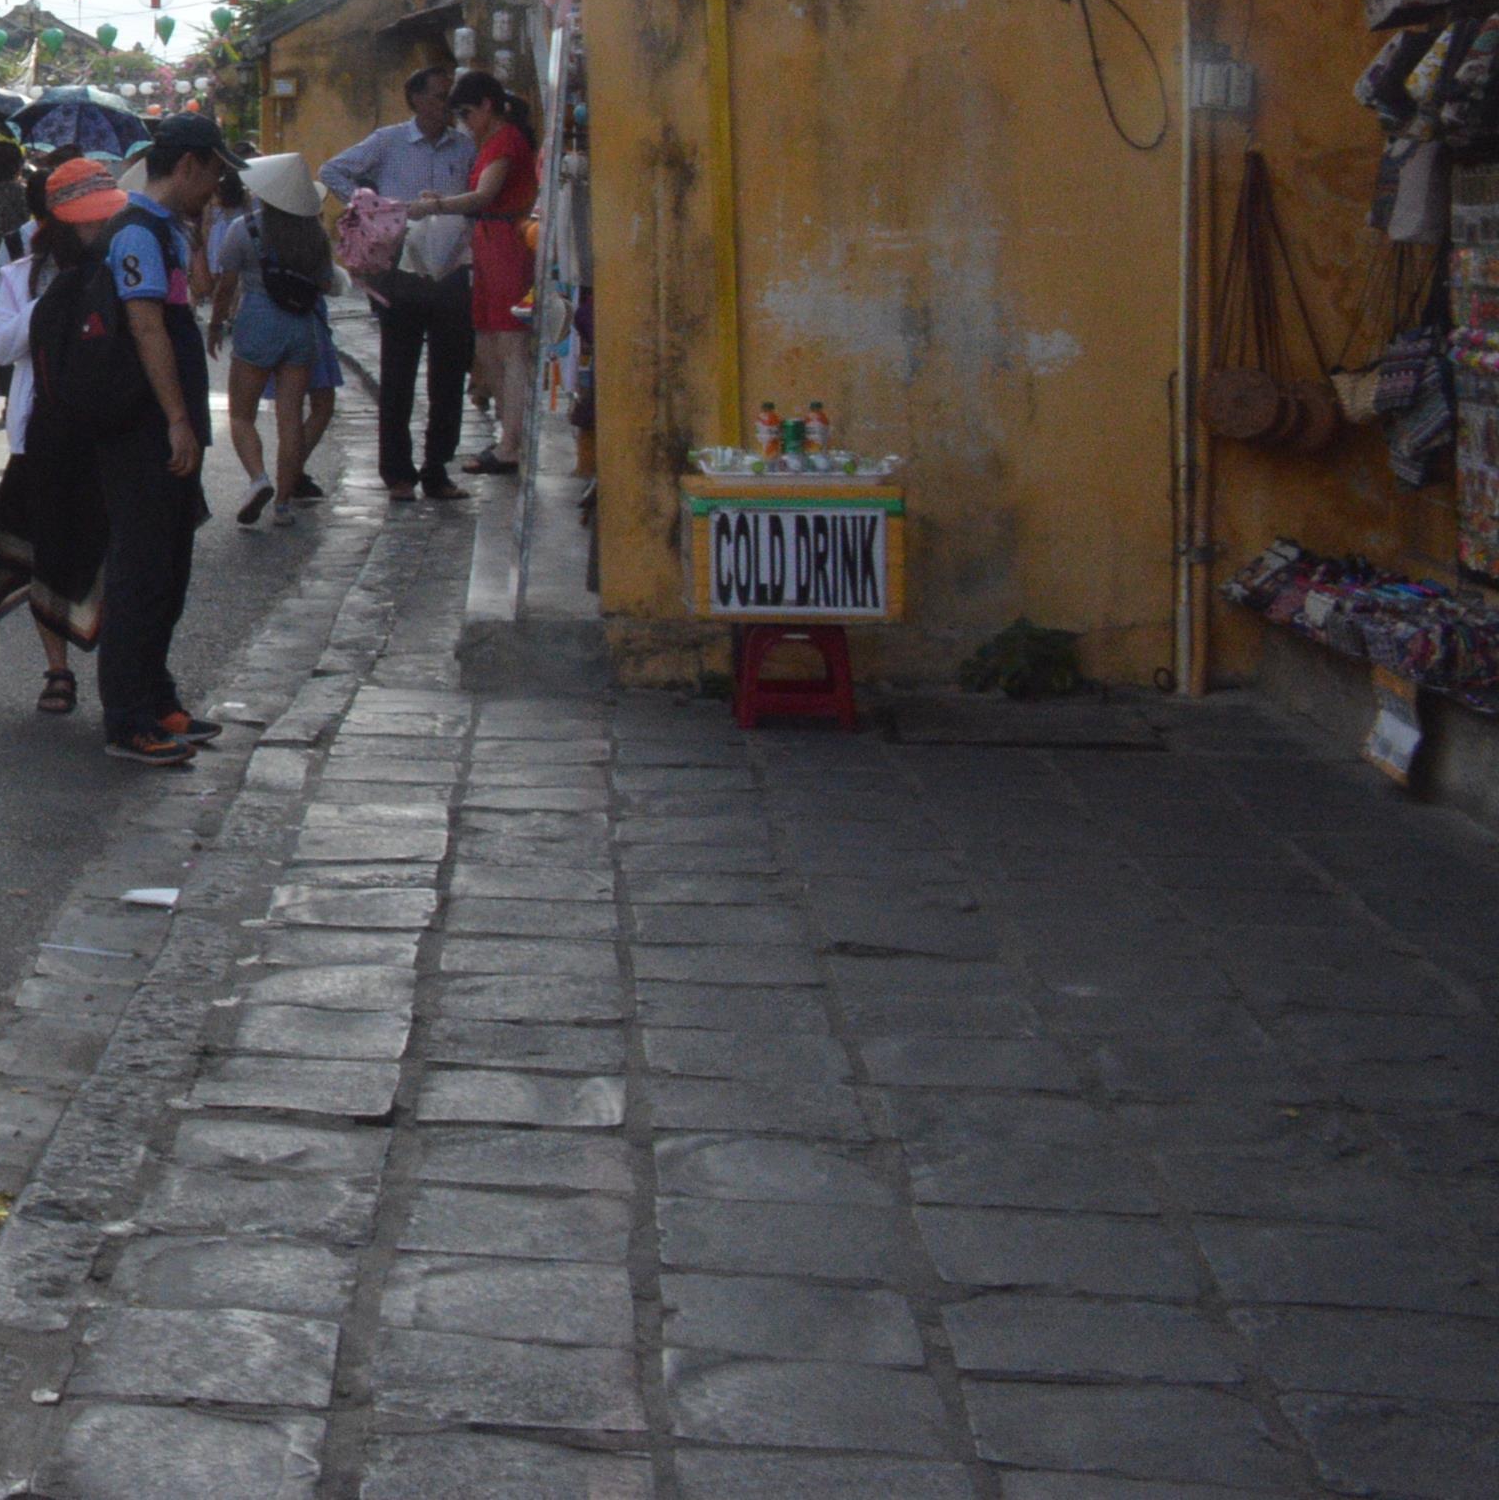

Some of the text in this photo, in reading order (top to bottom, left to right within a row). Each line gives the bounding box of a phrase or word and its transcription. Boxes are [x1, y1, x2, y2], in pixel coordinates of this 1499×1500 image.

[122, 253, 143, 288] 8
[714, 512, 880, 608] COLD DRINK
